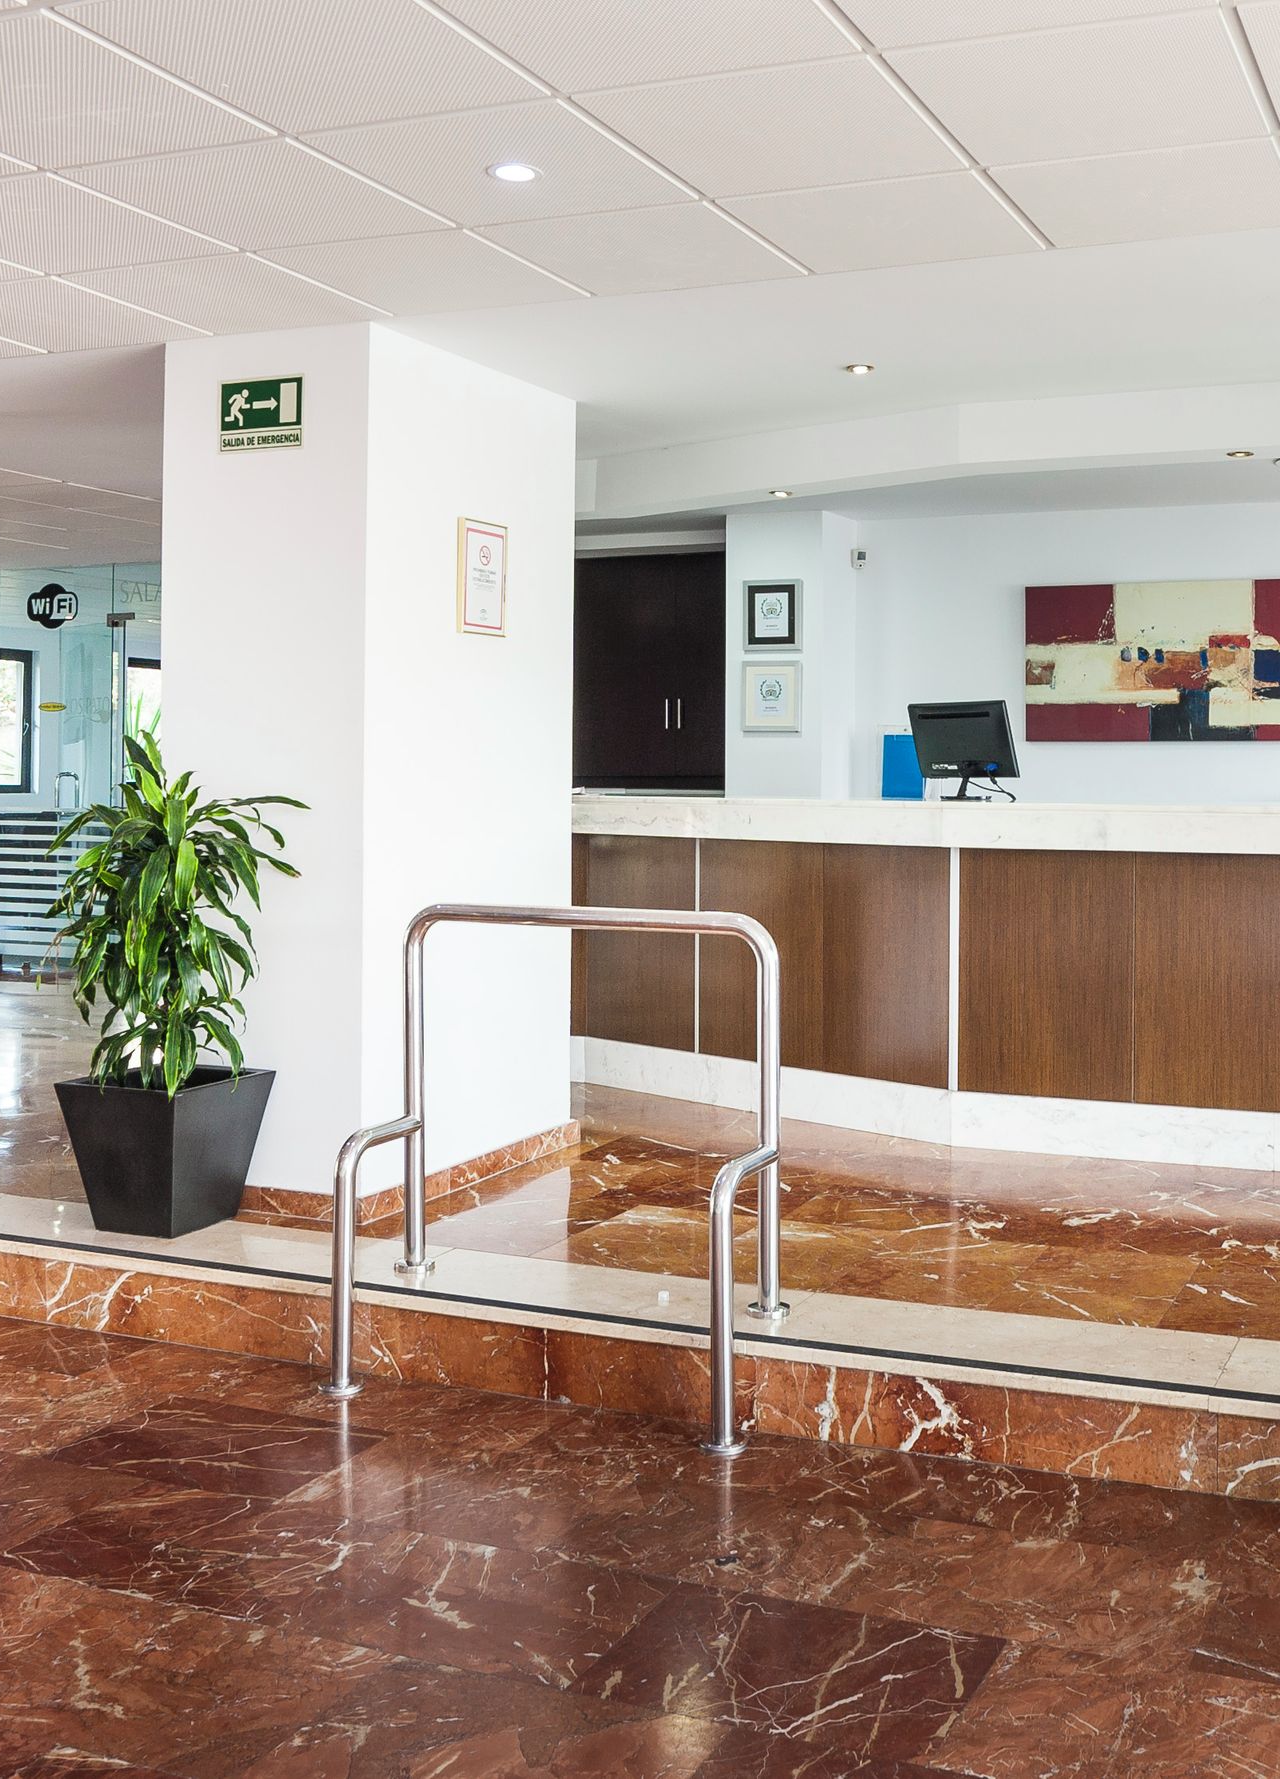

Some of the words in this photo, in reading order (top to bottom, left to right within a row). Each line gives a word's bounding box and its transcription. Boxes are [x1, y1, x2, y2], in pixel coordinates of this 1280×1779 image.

[223, 438, 245, 448] SALIDA
[247, 437, 255, 445] DE
[257, 433, 300, 445] EMERGENCIA
